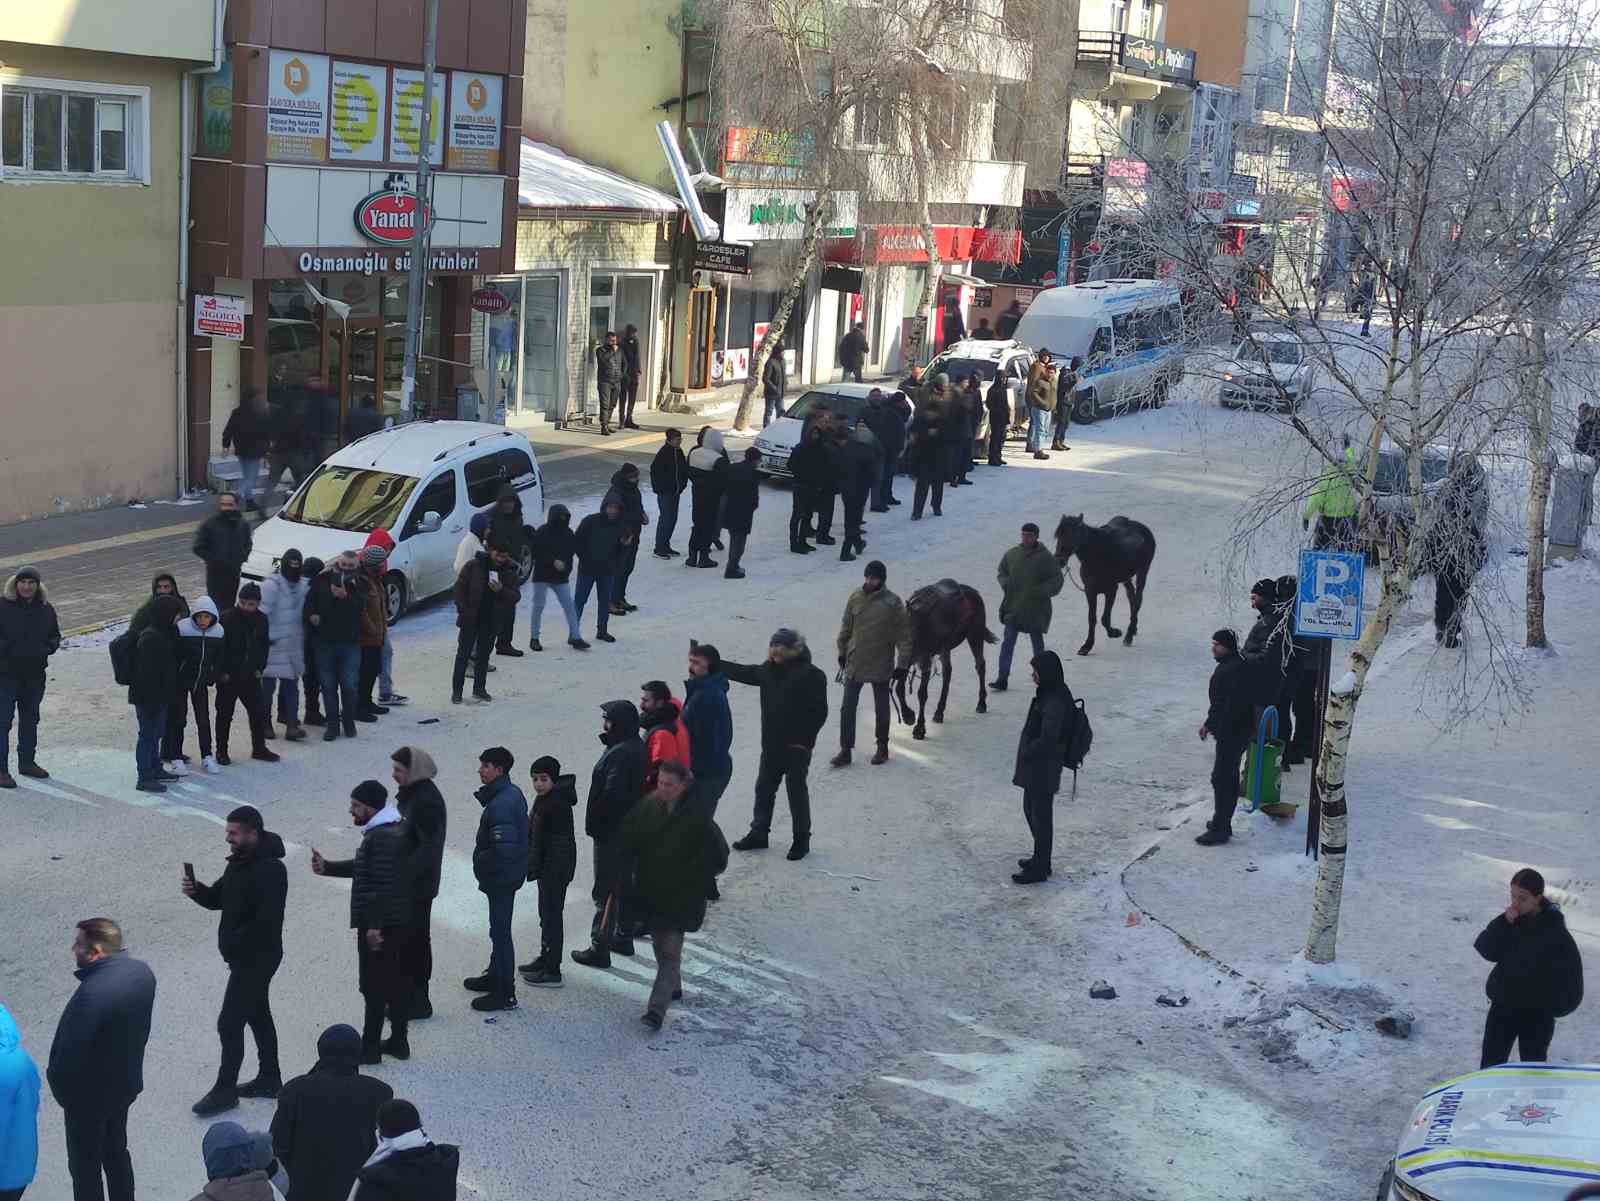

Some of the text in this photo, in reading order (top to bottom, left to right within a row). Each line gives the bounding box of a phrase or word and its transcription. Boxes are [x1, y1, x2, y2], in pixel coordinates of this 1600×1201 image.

[299, 250, 479, 275] Osmanoğlu sü rünleri
[1315, 560, 1350, 601] P
